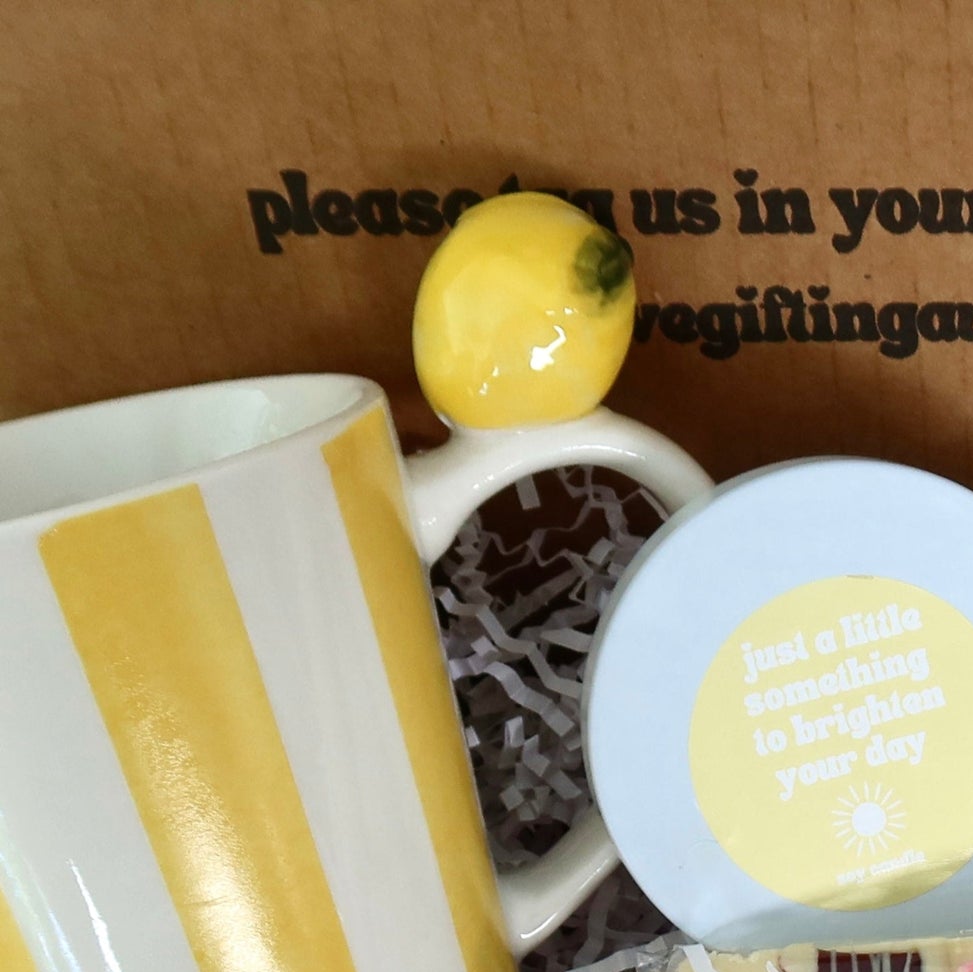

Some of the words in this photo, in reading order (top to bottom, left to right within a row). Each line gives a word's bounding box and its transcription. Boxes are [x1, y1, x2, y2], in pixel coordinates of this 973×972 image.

[630, 186, 721, 236] us
[733, 168, 815, 235] in
[741, 631, 809, 684] just
[814, 629, 837, 655] a
[839, 603, 923, 650] little
[744, 647, 930, 717] something
[753, 727, 788, 756] to
[790, 686, 946, 746] brighten
[775, 750, 858, 802] your
[865, 731, 926, 765] day
